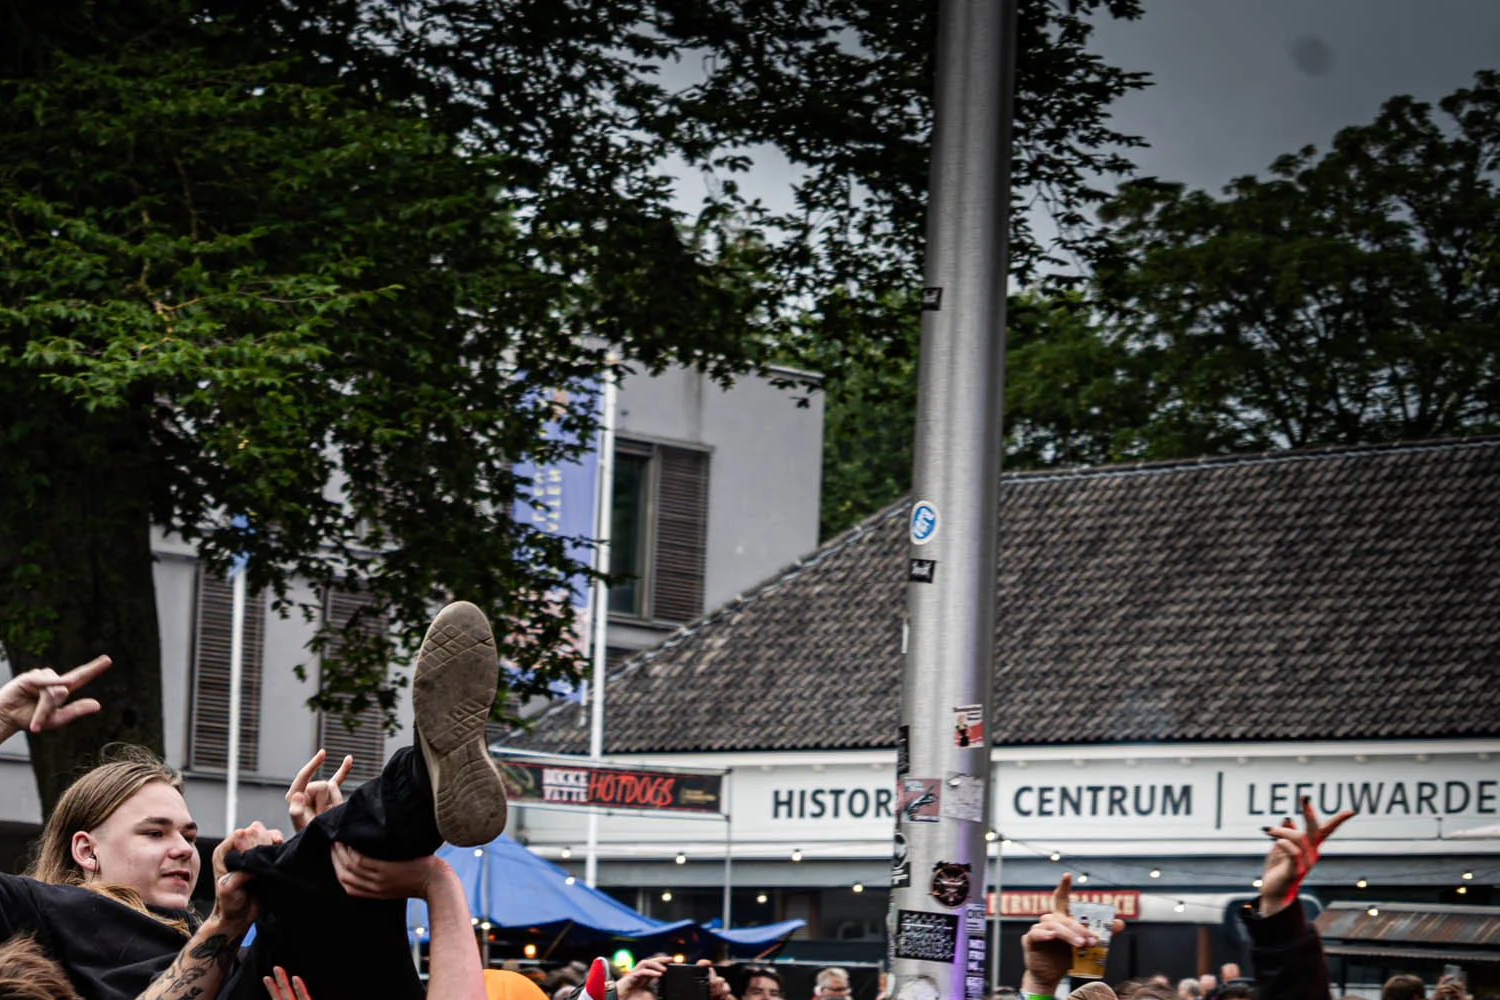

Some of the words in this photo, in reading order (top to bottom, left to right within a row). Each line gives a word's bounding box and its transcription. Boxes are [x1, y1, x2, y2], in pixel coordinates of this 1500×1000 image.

[588, 772, 676, 807] HOTDOGS
[773, 788, 893, 819] HISTOR
[1013, 785, 1193, 817] CENTRUM
[1248, 780, 1499, 816] LEEUWARDE
